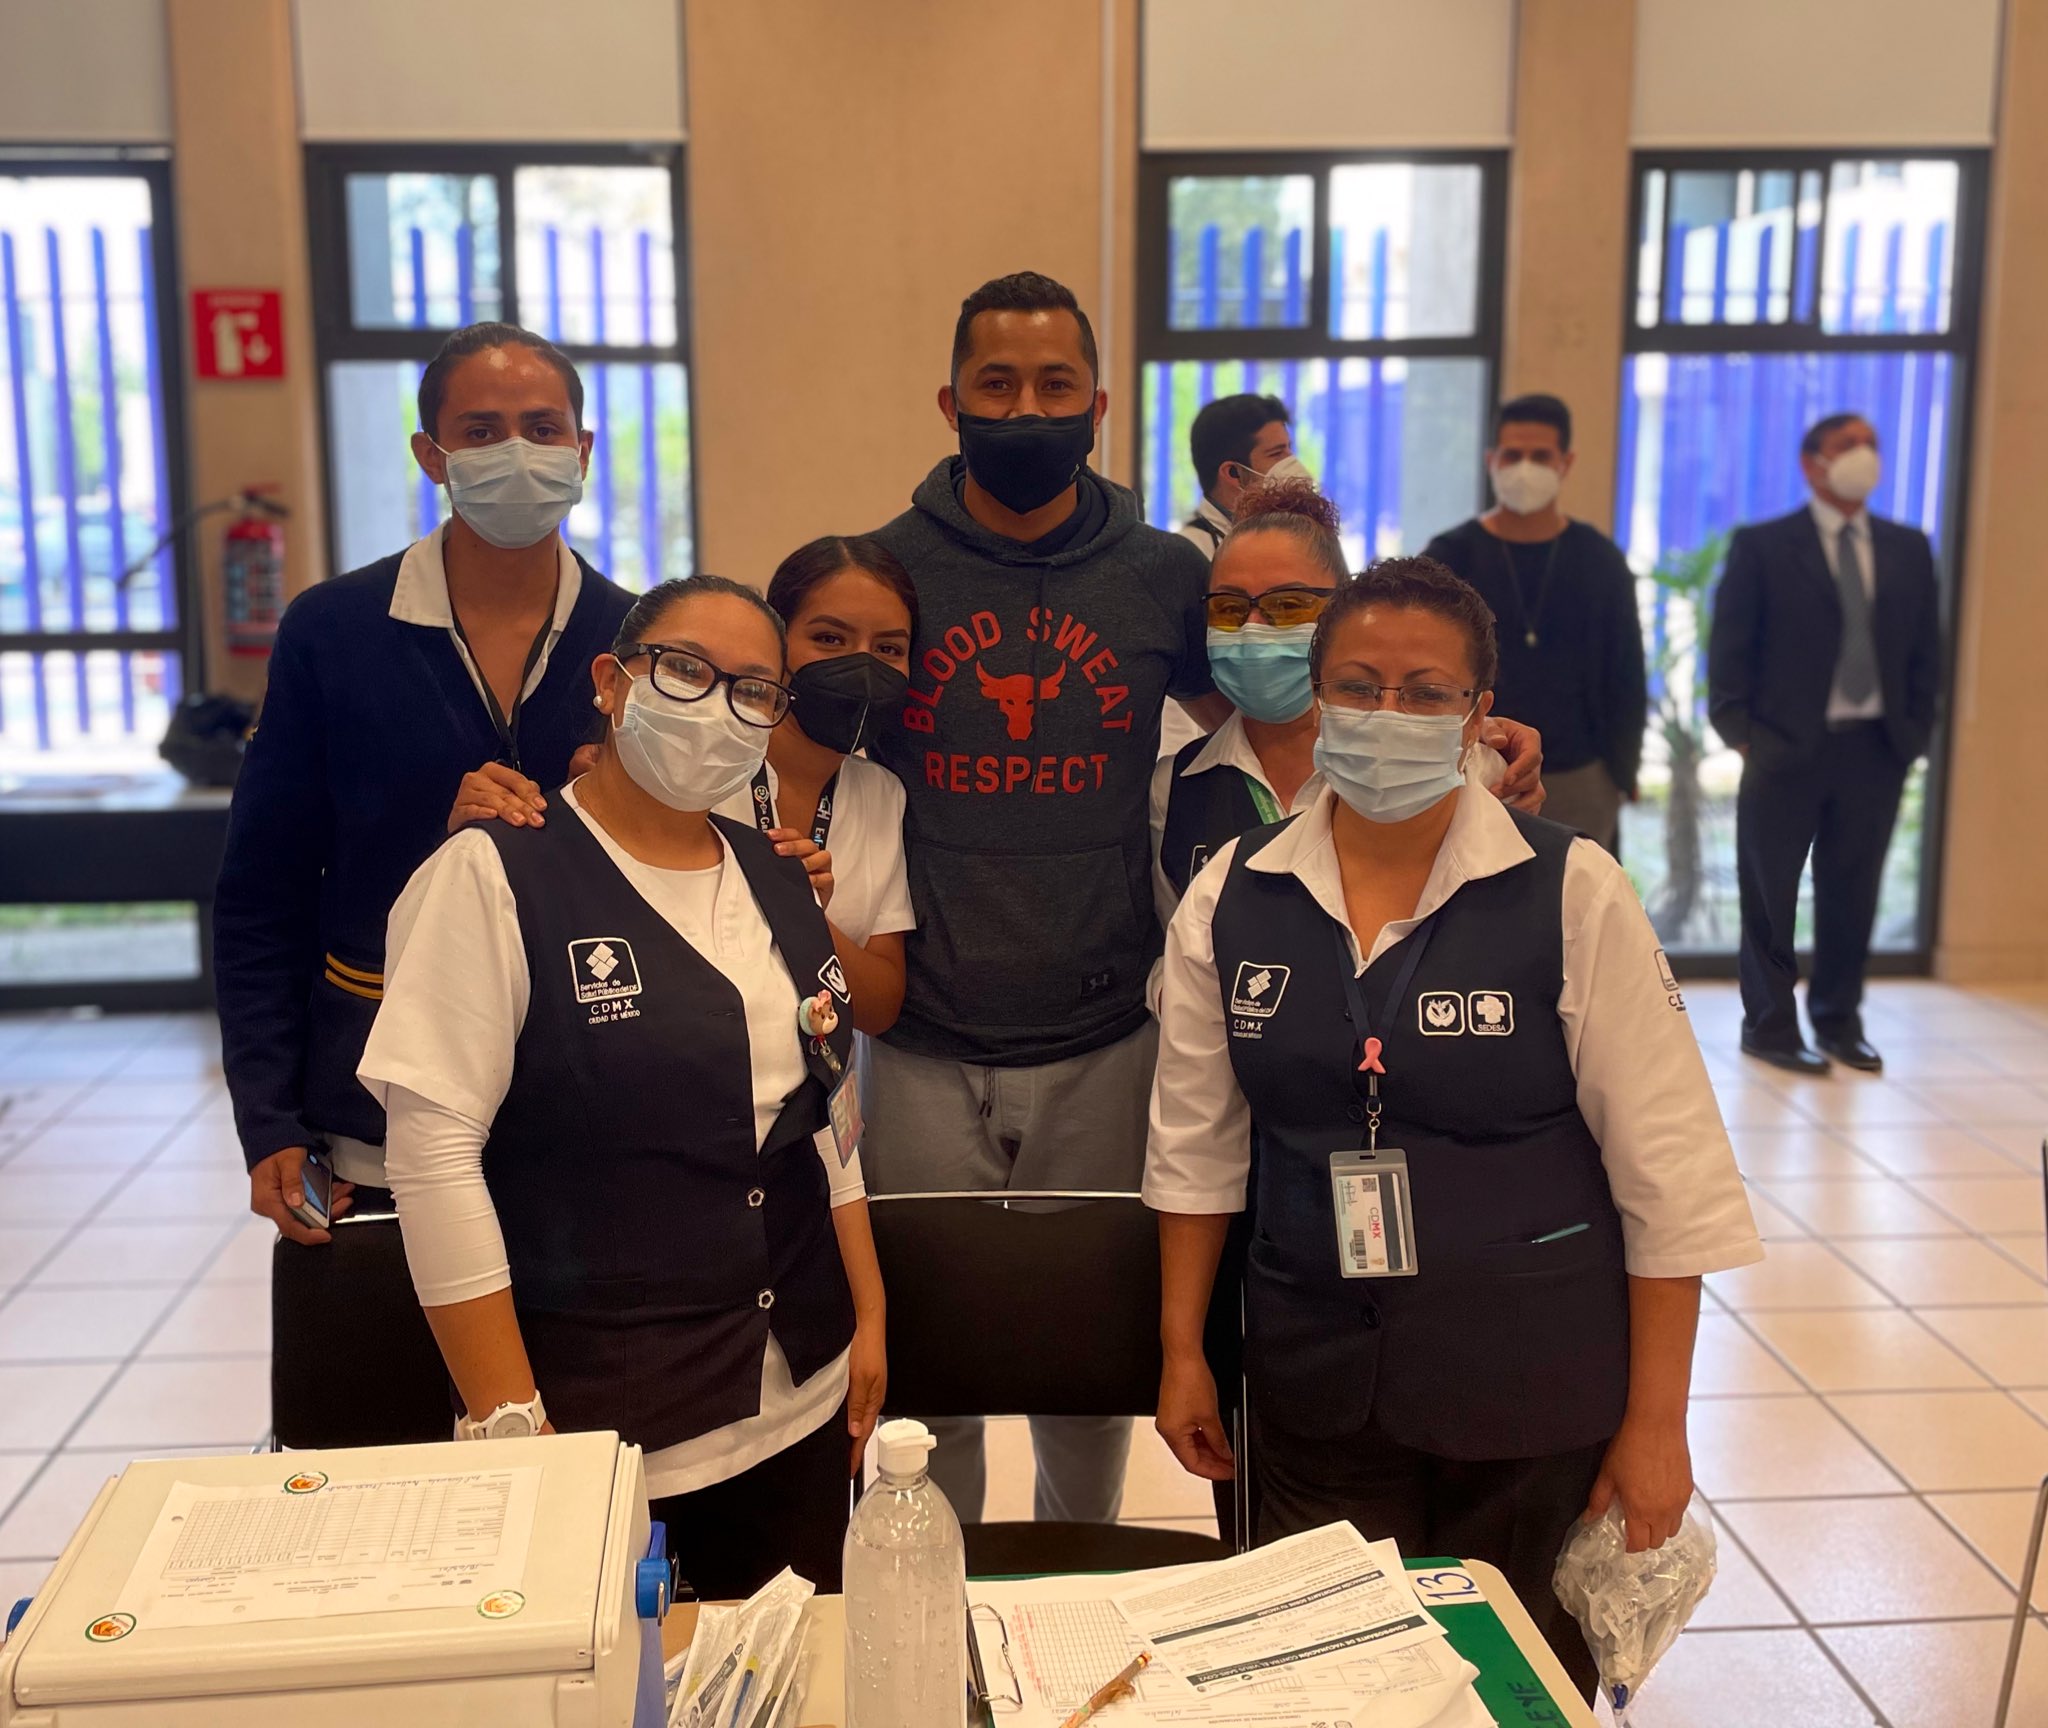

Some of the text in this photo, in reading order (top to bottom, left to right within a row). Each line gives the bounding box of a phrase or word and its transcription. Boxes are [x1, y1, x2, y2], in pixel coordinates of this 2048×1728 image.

[903, 606, 1134, 735] BLOOD SWEAT
[924, 752, 1109, 794] RESPECT
[580, 981, 608, 991] Servicios
[591, 999, 634, 1015] CDMX
[588, 1015, 608, 1025] CIUDAD
[1234, 1019, 1263, 1031] CDMX
[1477, 1024, 1506, 1032] SEDESA
[1369, 1207, 1382, 1239] CDMX
[1416, 1572, 1479, 1600] 13
[1355, 1623, 1408, 1644] COMPROBANTE
[1269, 1654, 1298, 1665] CONTRA
